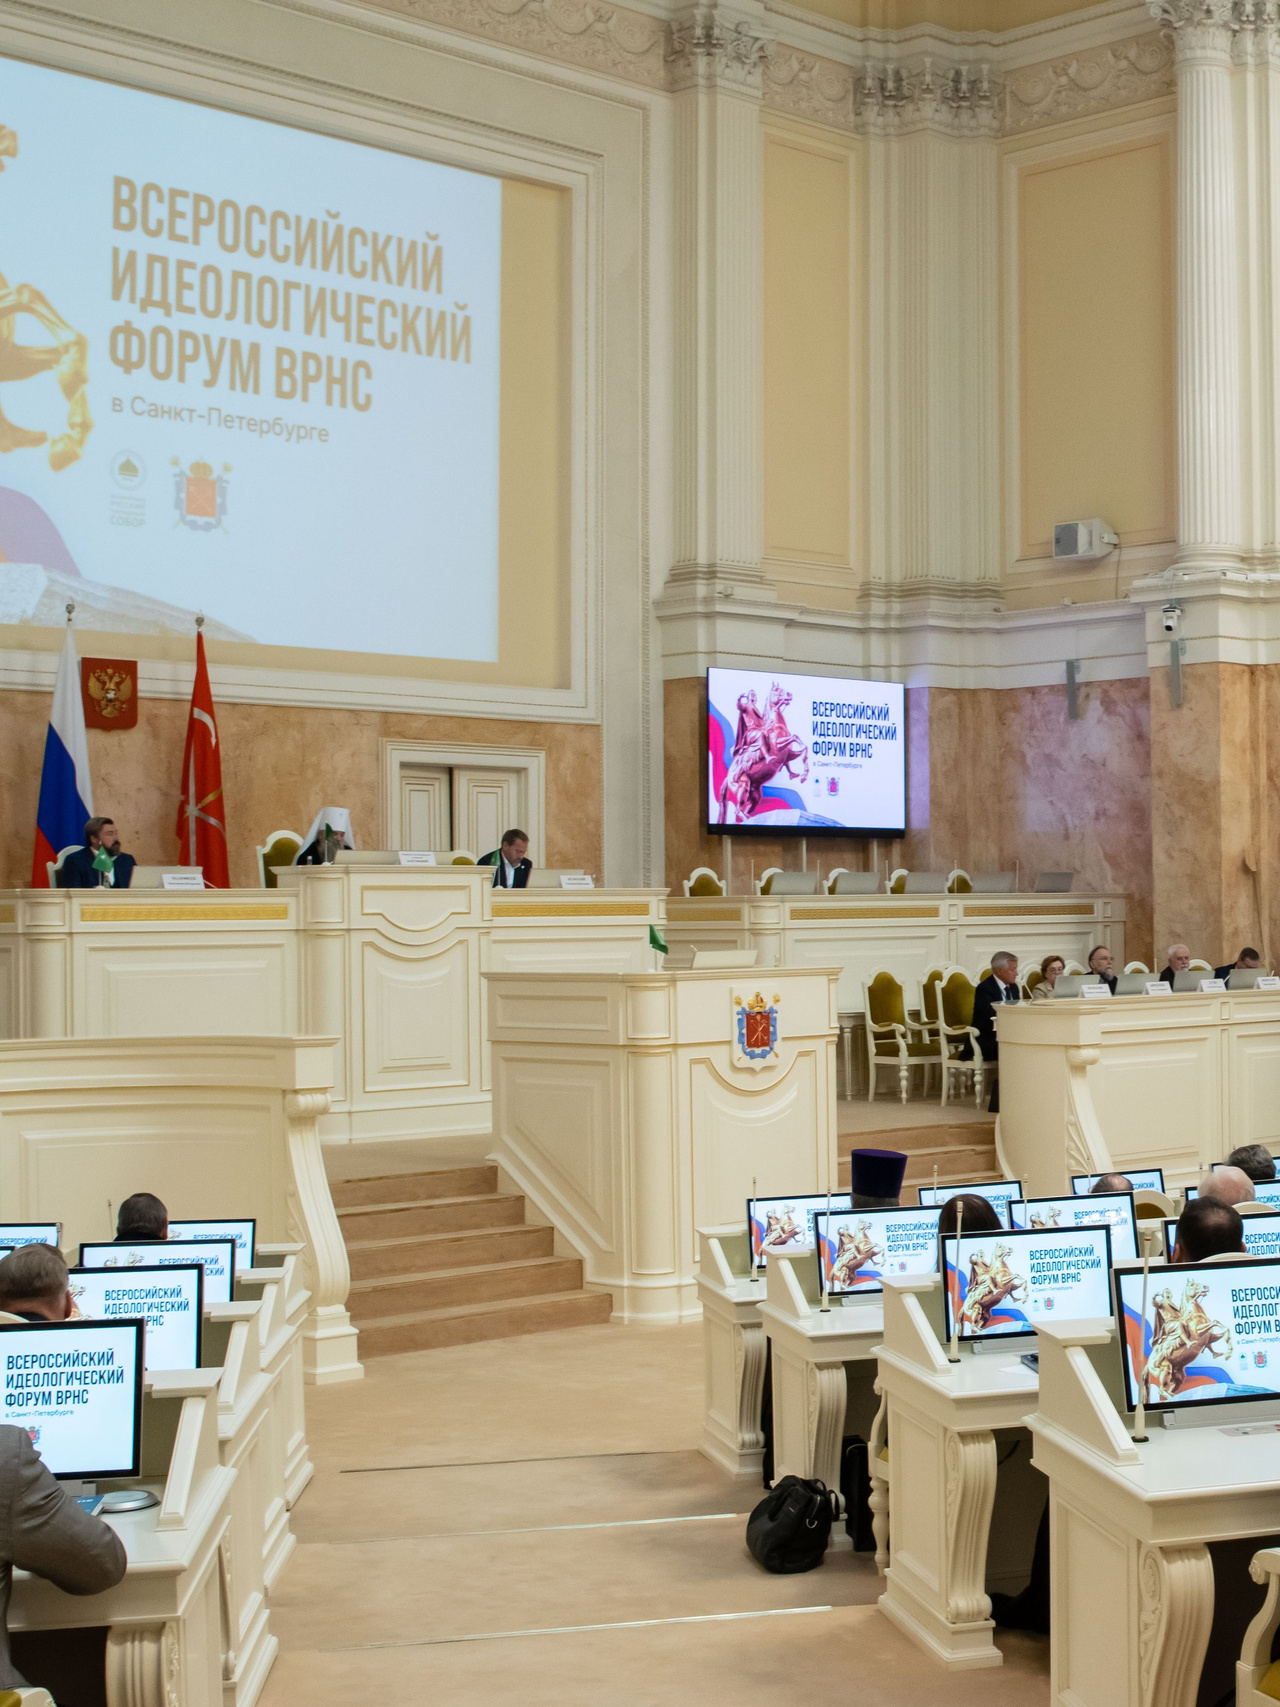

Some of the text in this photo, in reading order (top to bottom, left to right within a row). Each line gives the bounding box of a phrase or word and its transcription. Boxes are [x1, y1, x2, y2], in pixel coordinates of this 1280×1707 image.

[112, 174, 444, 295] ВСЕРОССИЙСКИЙ
[110, 246, 472, 364] ИДЕОЛОГИЧЕСКИЙ
[109, 319, 373, 412] ФОРУМ ВРНС
[111, 395, 330, 444] в Санкт-Петербурге
[812, 701, 889, 721] ВСЕРОССИЙСКИЙ
[812, 721, 897, 741] ИДЕОЛОГИЧЕСКИЙ
[812, 740, 873, 759] ФОРУМ ВРНС
[886, 1220, 939, 1233] ВСЕРОССИЙСКИЙ
[887, 1241, 929, 1253] ФОРУМ ВРНС
[1029, 1244, 1095, 1261] ВСЕРОССИЙСКИЙ
[1030, 1256, 1102, 1274] ИДЕОЛОГИЧЕСКИЙ
[1030, 1271, 1082, 1285] ФОРУМ ВРНС
[104, 1285, 183, 1301] ВСЕРОССИЙСКИЙ
[104, 1298, 190, 1315] ИДЕОЛОГИЧЕСКИЙ
[1235, 1319, 1272, 1335] ФОРУМ
[7, 1347, 115, 1371] ВСЕРОССИЙСКИЙ
[5, 1365, 125, 1390] ИДЕОЛОГИЧЕСКИЙ
[4, 1389, 89, 1408] ФОРУМ ВРНС
